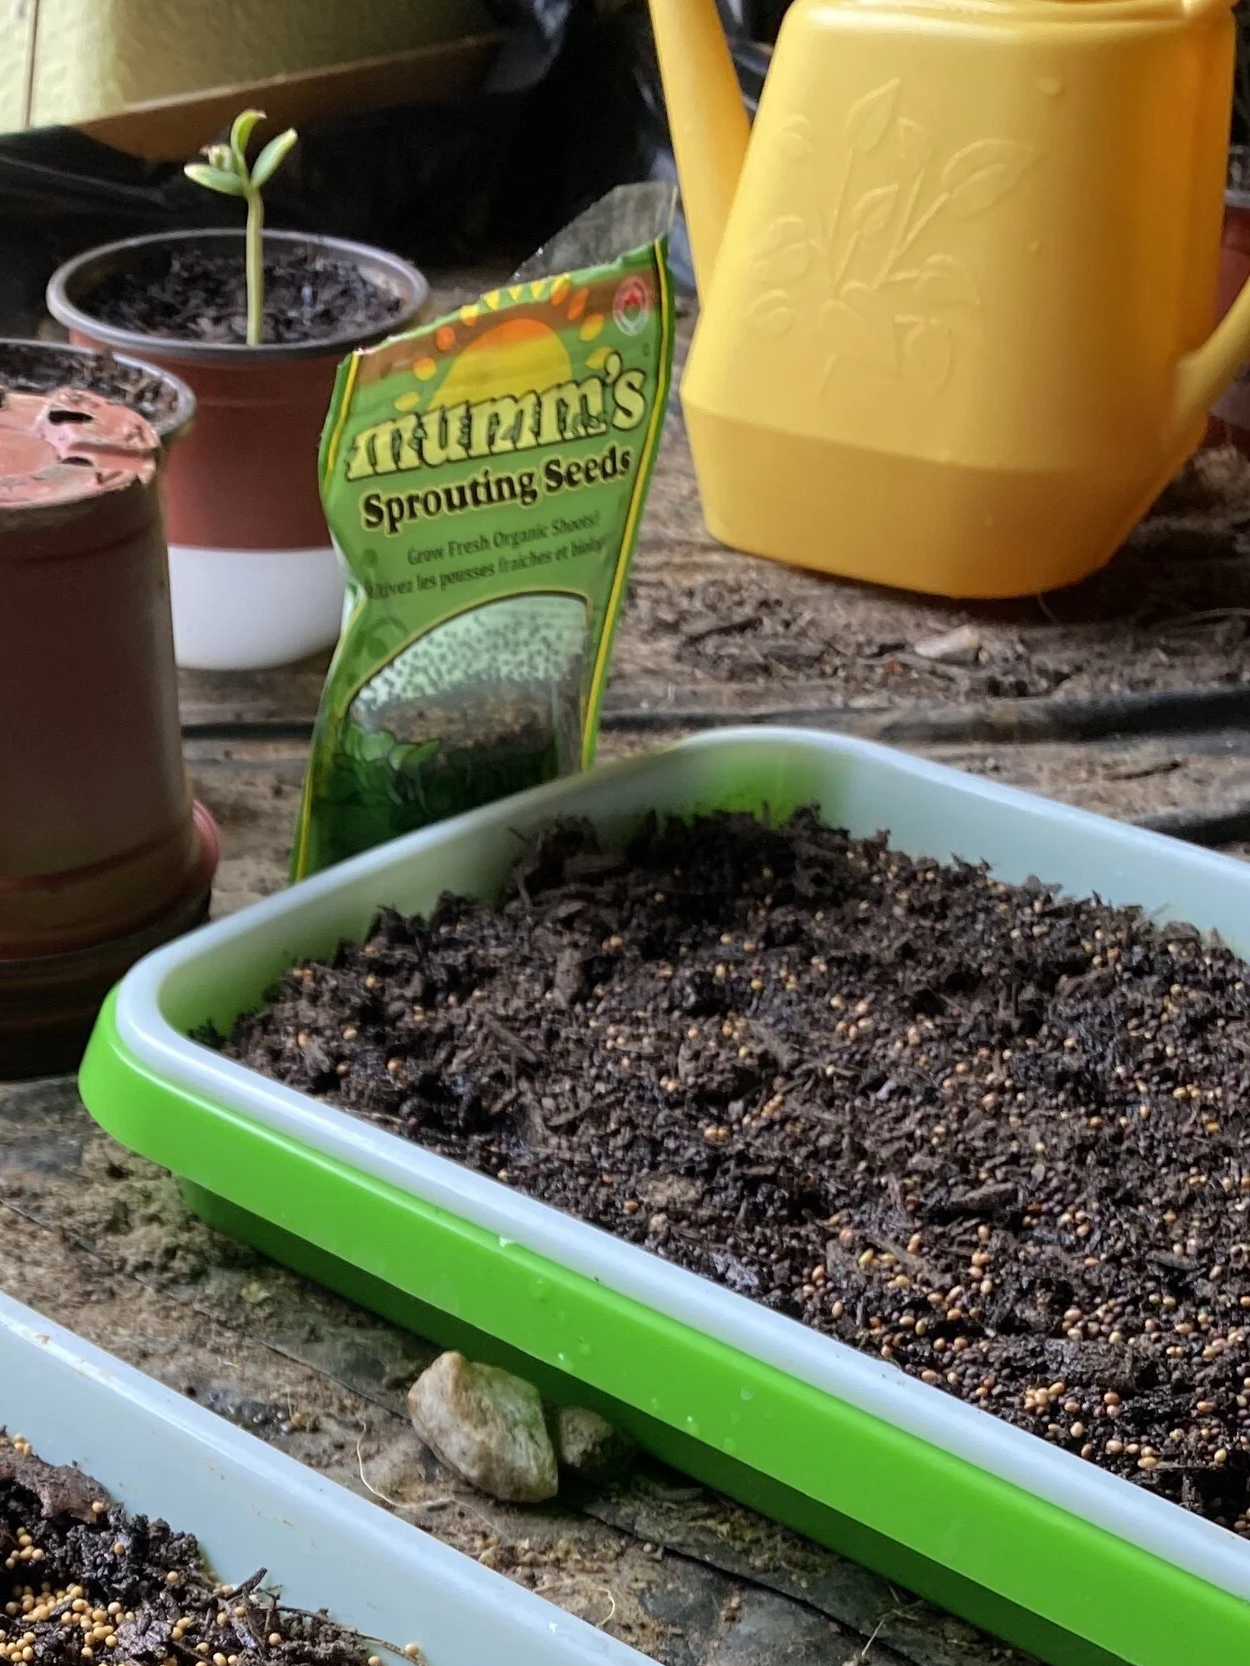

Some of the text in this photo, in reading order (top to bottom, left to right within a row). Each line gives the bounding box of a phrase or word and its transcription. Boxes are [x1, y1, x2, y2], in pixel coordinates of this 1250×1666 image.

[347, 350, 647, 480] mumm's
[363, 446, 630, 533] Sprouting Seeds
[448, 534, 489, 557] Fresh
